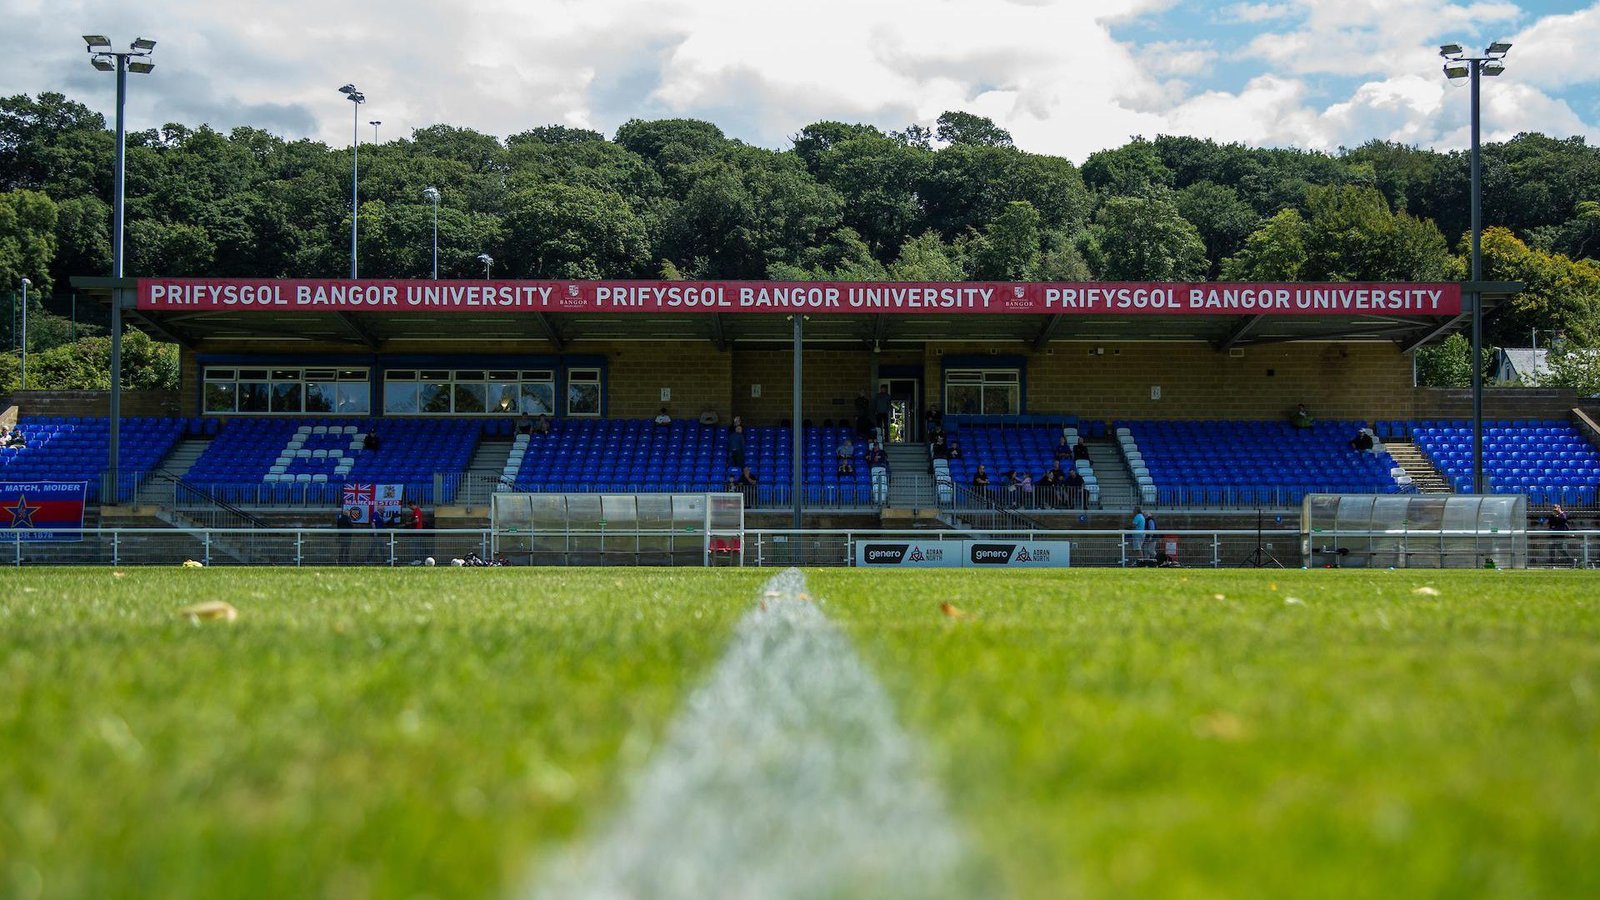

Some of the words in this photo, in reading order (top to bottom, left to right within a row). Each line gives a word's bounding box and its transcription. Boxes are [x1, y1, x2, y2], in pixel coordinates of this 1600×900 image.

[151, 285, 288, 305] PRIFYSGOL
[297, 286, 398, 305] BANGOR
[407, 286, 553, 306] UNIVERSITY
[596, 287, 732, 306] PRIFYSGOL
[740, 287, 840, 307] BANGOR
[849, 288, 994, 307] UNIVERSITY
[1046, 288, 1181, 308] PRIFYSGOL
[1189, 289, 1290, 309] BANGOR
[1296, 289, 1442, 309] UNIVERSITY
[5, 484, 41, 493] MATCH,
[43, 484, 81, 492] MOIDER
[0, 531, 30, 539] ANGOR
[869, 550, 901, 560] genero
[976, 550, 1008, 560] genero
